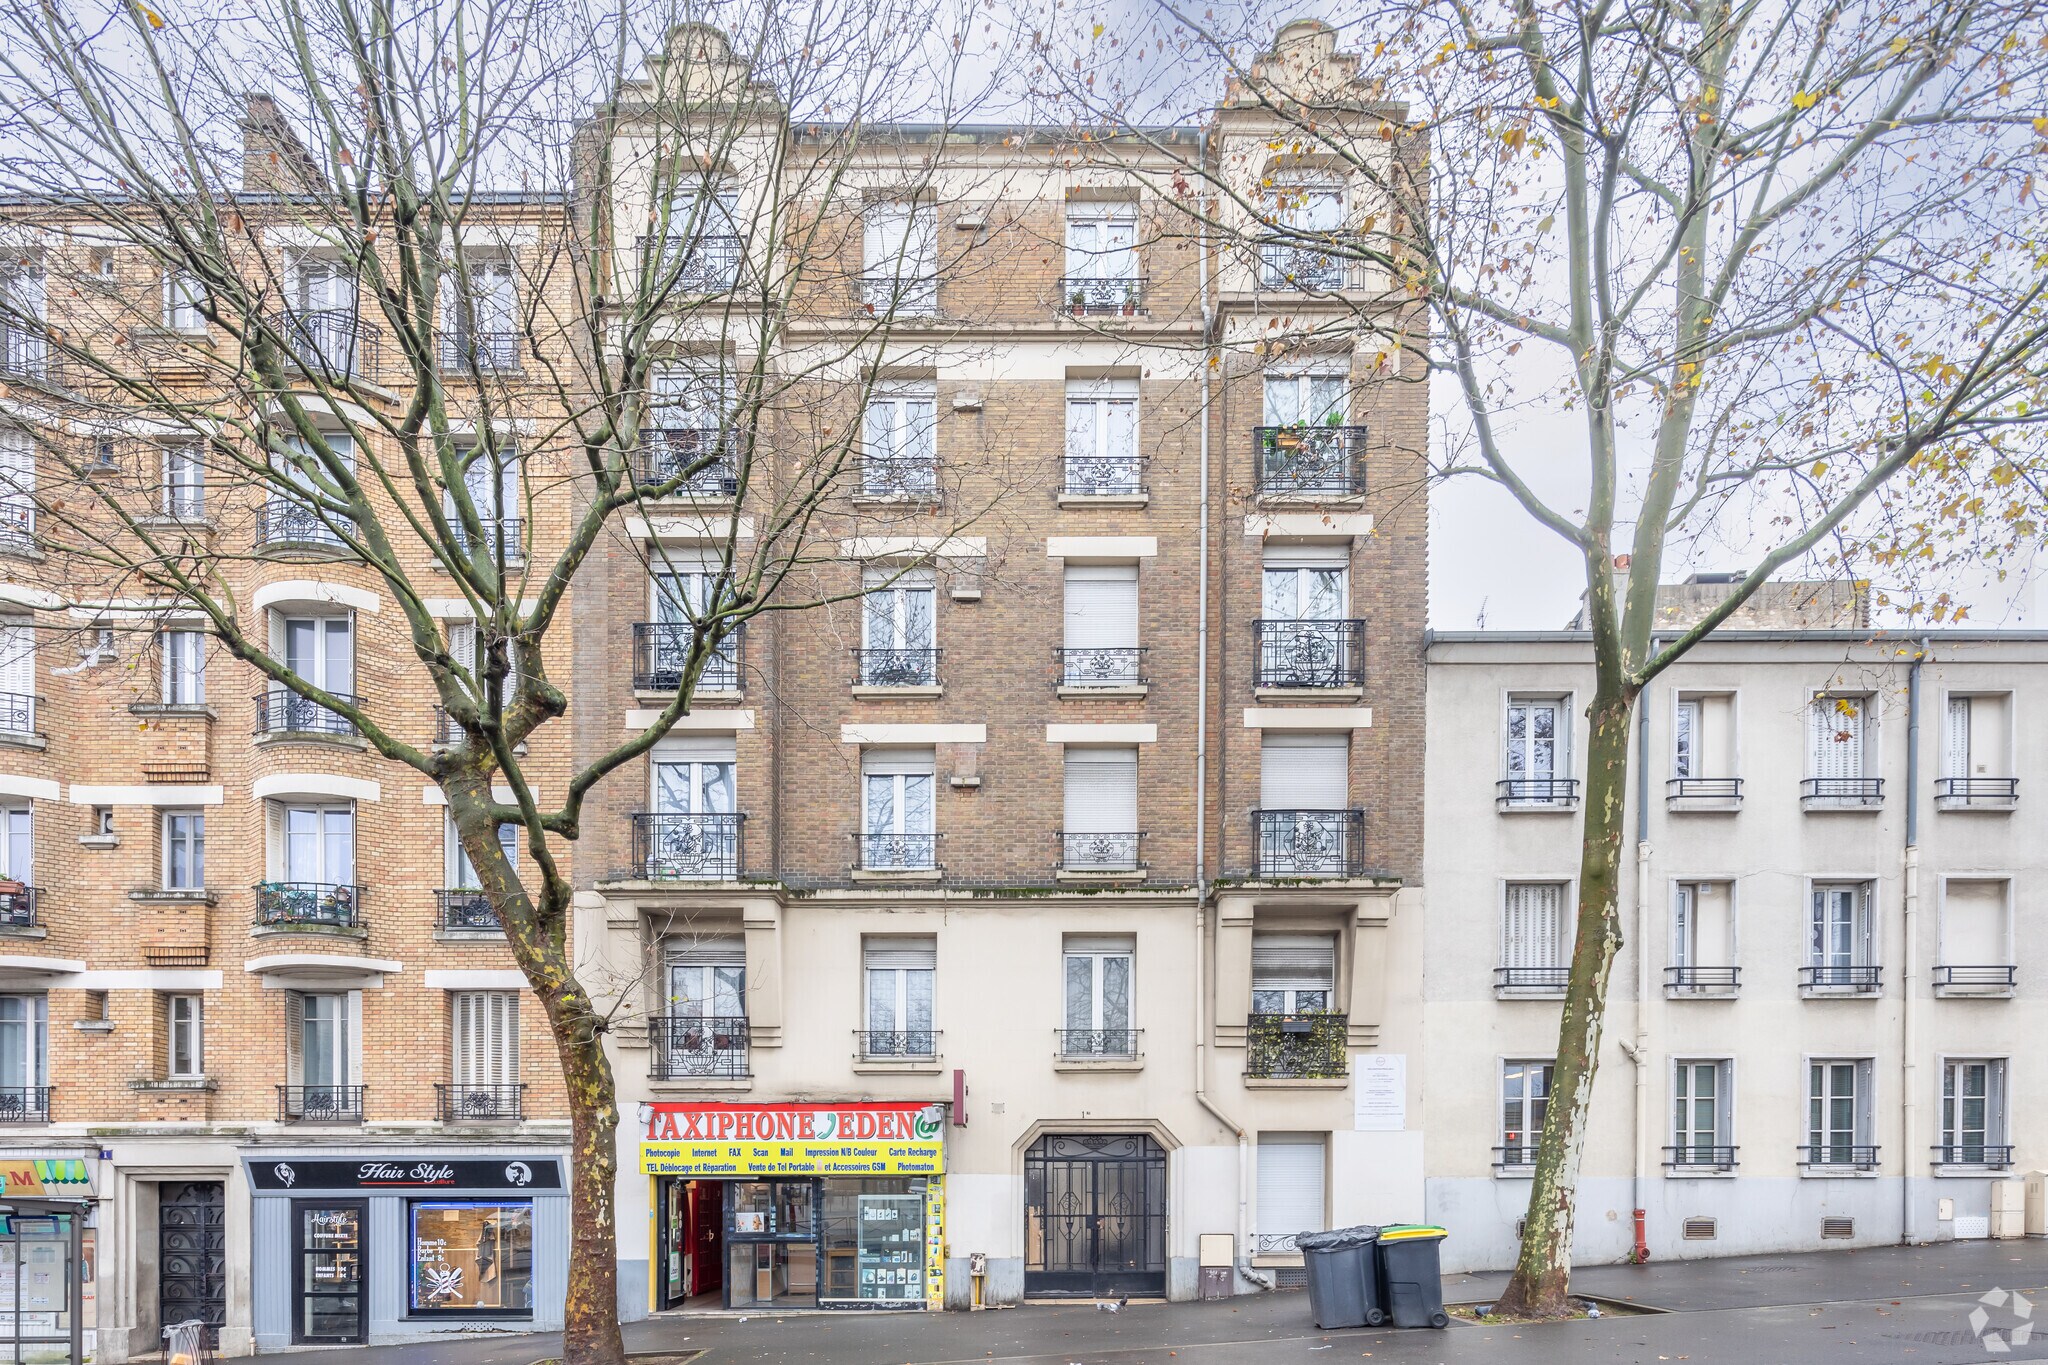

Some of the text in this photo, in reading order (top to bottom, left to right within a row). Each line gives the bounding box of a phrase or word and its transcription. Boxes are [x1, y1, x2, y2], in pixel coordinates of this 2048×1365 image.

[646, 1112, 815, 1140] TAXIPHONE
[645, 1148, 681, 1159] Photocopie
[692, 1148, 717, 1157] Internet
[728, 1148, 742, 1157] FAX
[753, 1147, 769, 1157] Scan
[780, 1147, 794, 1157] Mail
[805, 1147, 839, 1158] Impression
[853, 1147, 878, 1157] Couleur
[888, 1147, 906, 1157] Carte
[907, 1147, 937, 1158] Recharge
[357, 1162, 454, 1183] Hair Style
[646, 1162, 935, 1174] TEL Déblocage et Réparation Vente de Tel Portable et Accessoires GSM Photomaton
